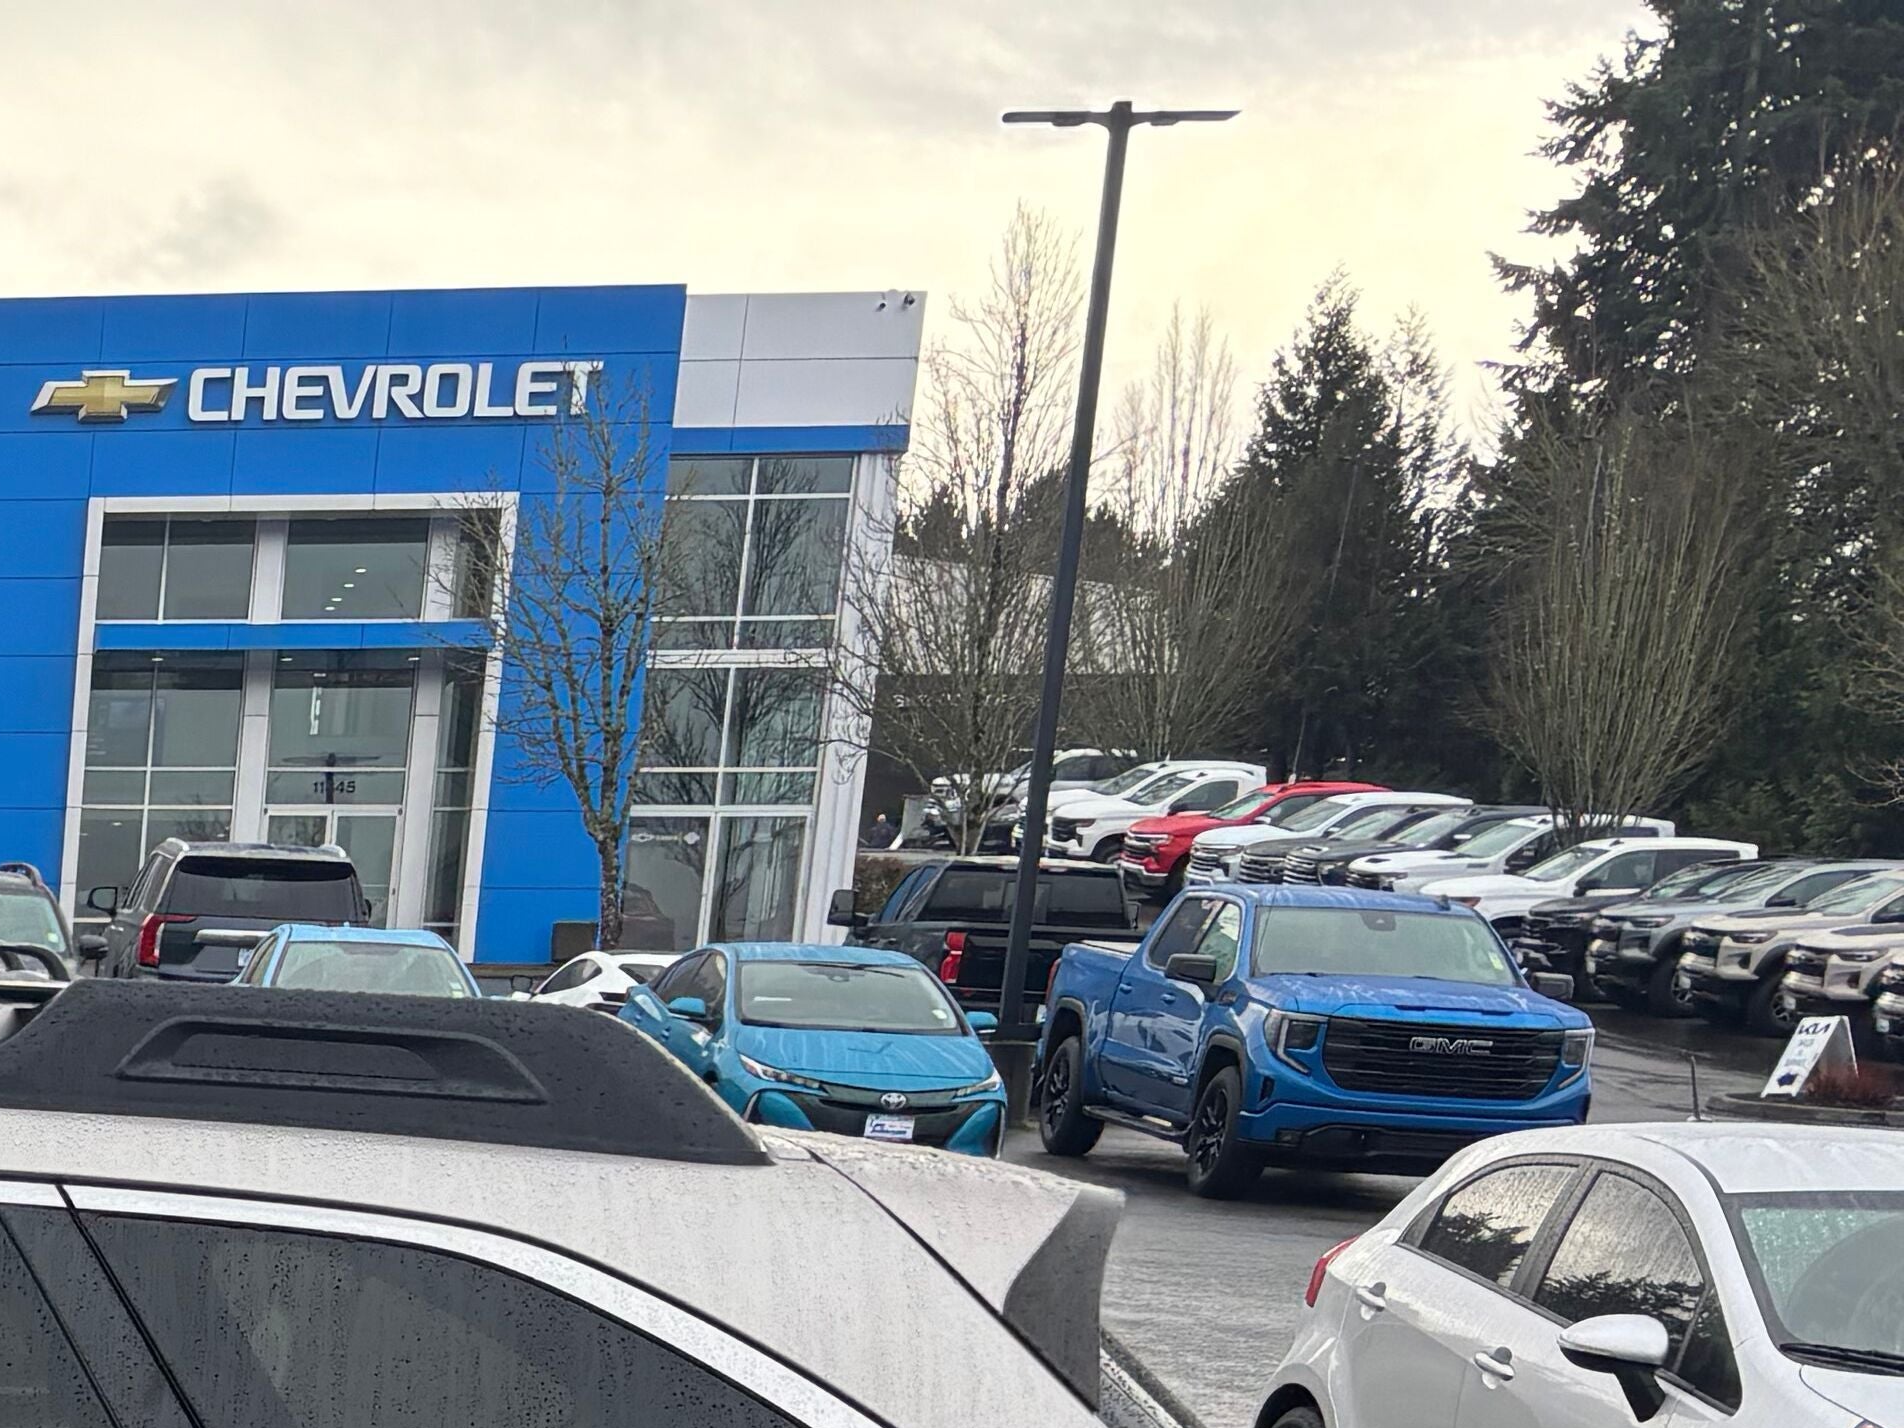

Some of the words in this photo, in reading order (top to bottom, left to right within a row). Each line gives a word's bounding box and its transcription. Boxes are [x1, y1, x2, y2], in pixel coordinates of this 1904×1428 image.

[188, 361, 604, 422] CHEVROLET
[313, 780, 356, 794] 1145
[1409, 1036, 1494, 1055] GMC
